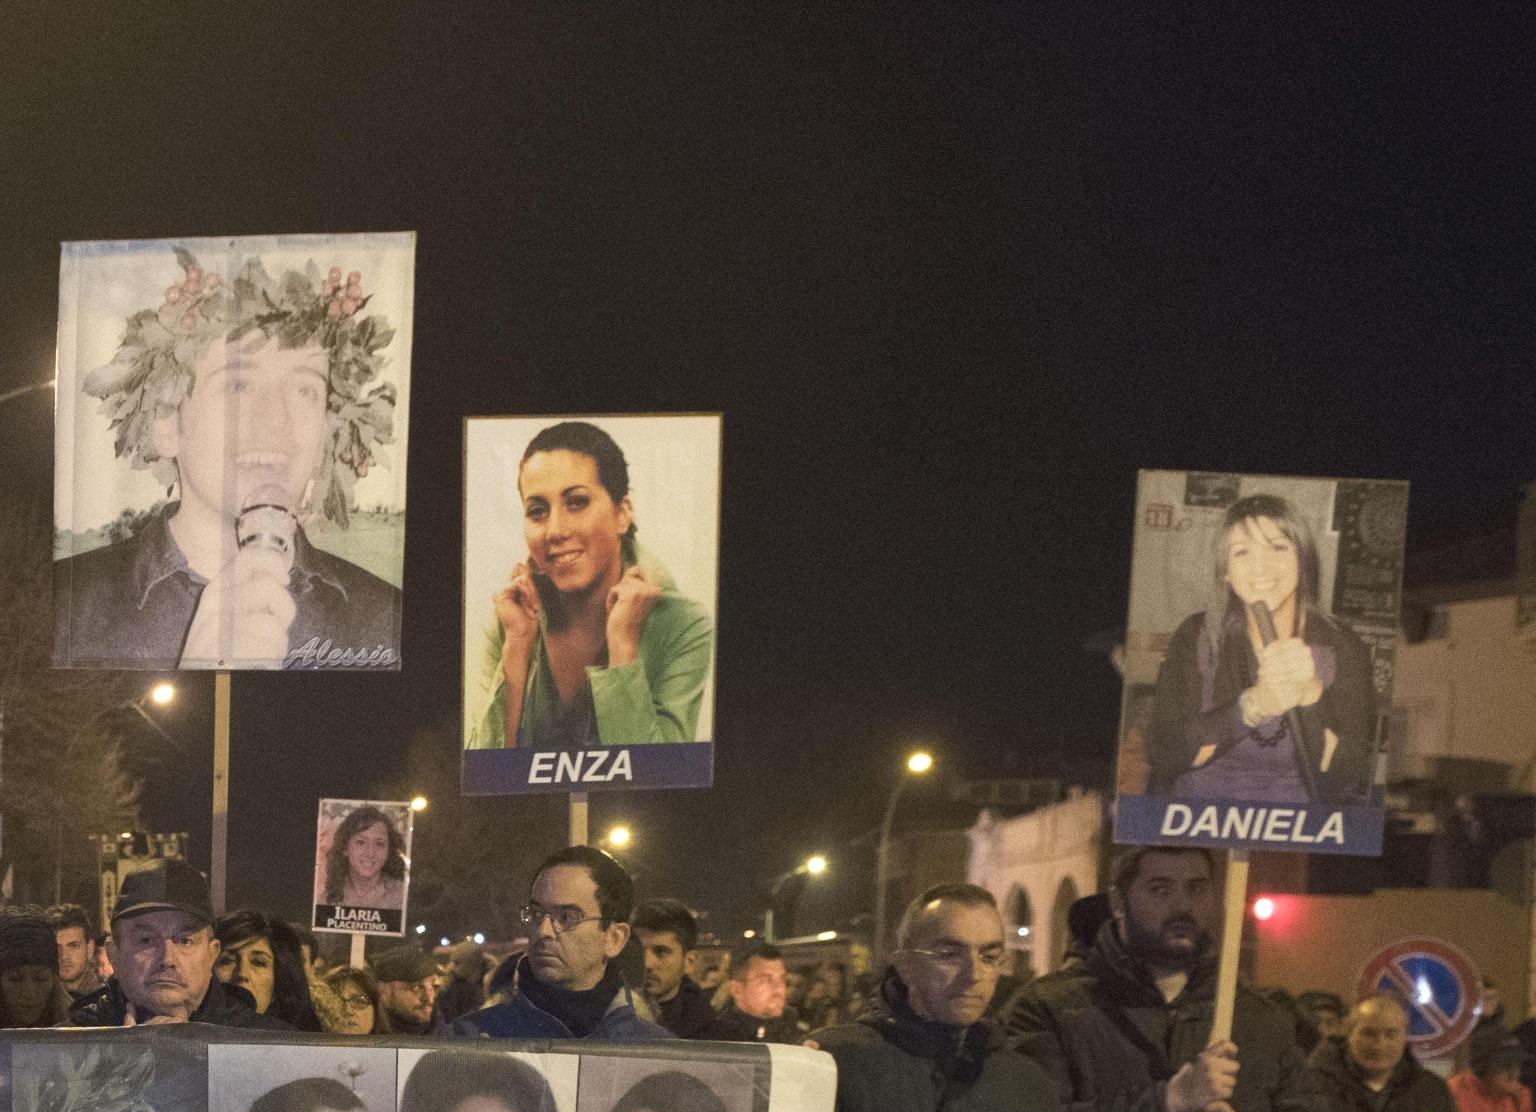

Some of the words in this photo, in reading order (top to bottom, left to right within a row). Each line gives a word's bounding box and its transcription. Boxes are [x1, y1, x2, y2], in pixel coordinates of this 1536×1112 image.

[283, 636, 399, 668] Alessio
[527, 750, 633, 785] ENZA
[1160, 803, 1345, 845] DANIELA
[334, 906, 381, 922] ILARIA
